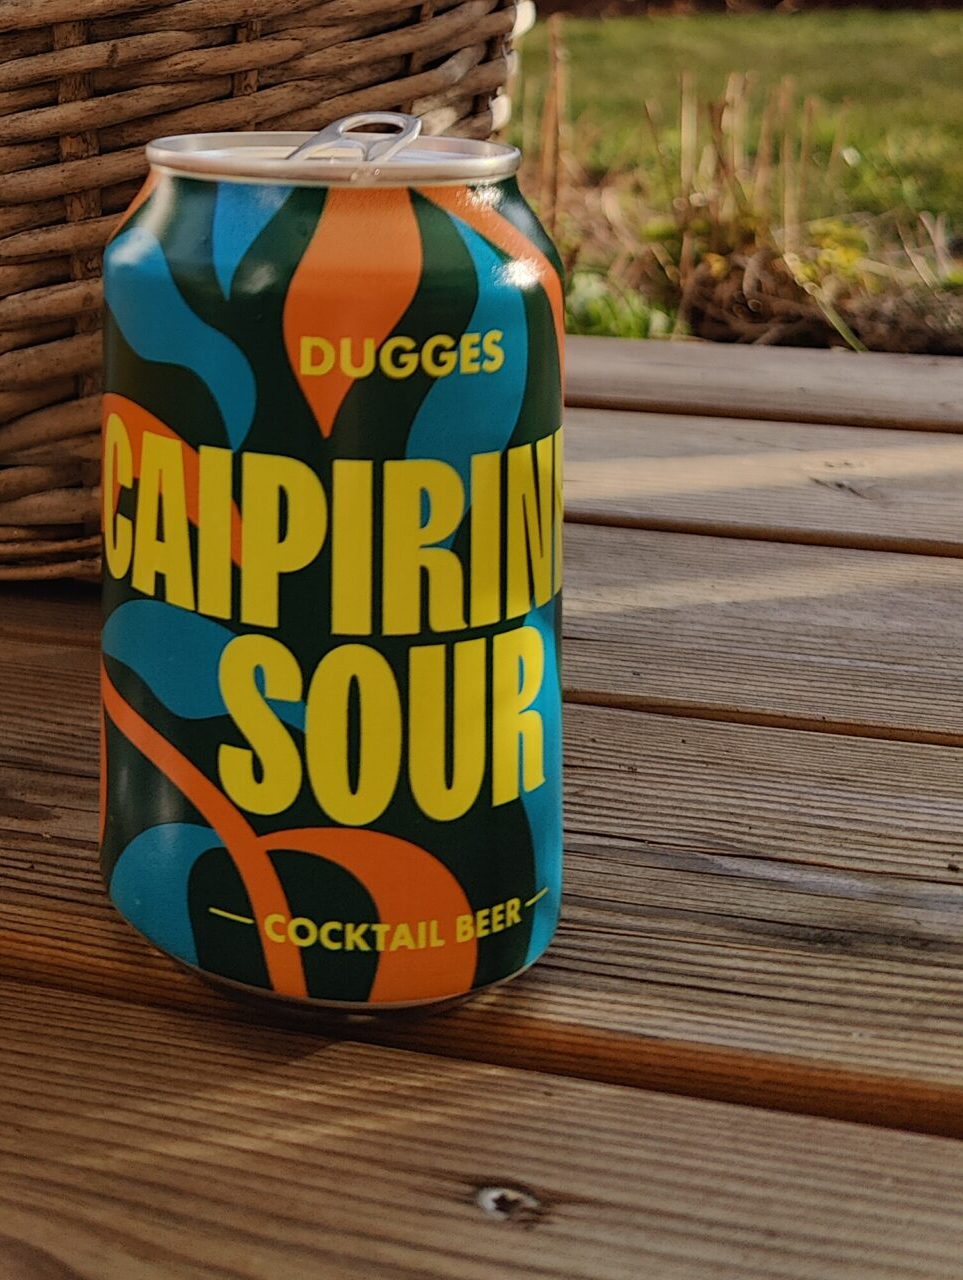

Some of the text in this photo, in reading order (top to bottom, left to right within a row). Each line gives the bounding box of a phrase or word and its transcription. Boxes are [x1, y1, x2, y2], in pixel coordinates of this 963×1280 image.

[299, 329, 505, 379] DUGGES
[218, 626, 545, 826] SOUR
[264, 898, 522, 952] COCKTAIL BEER
